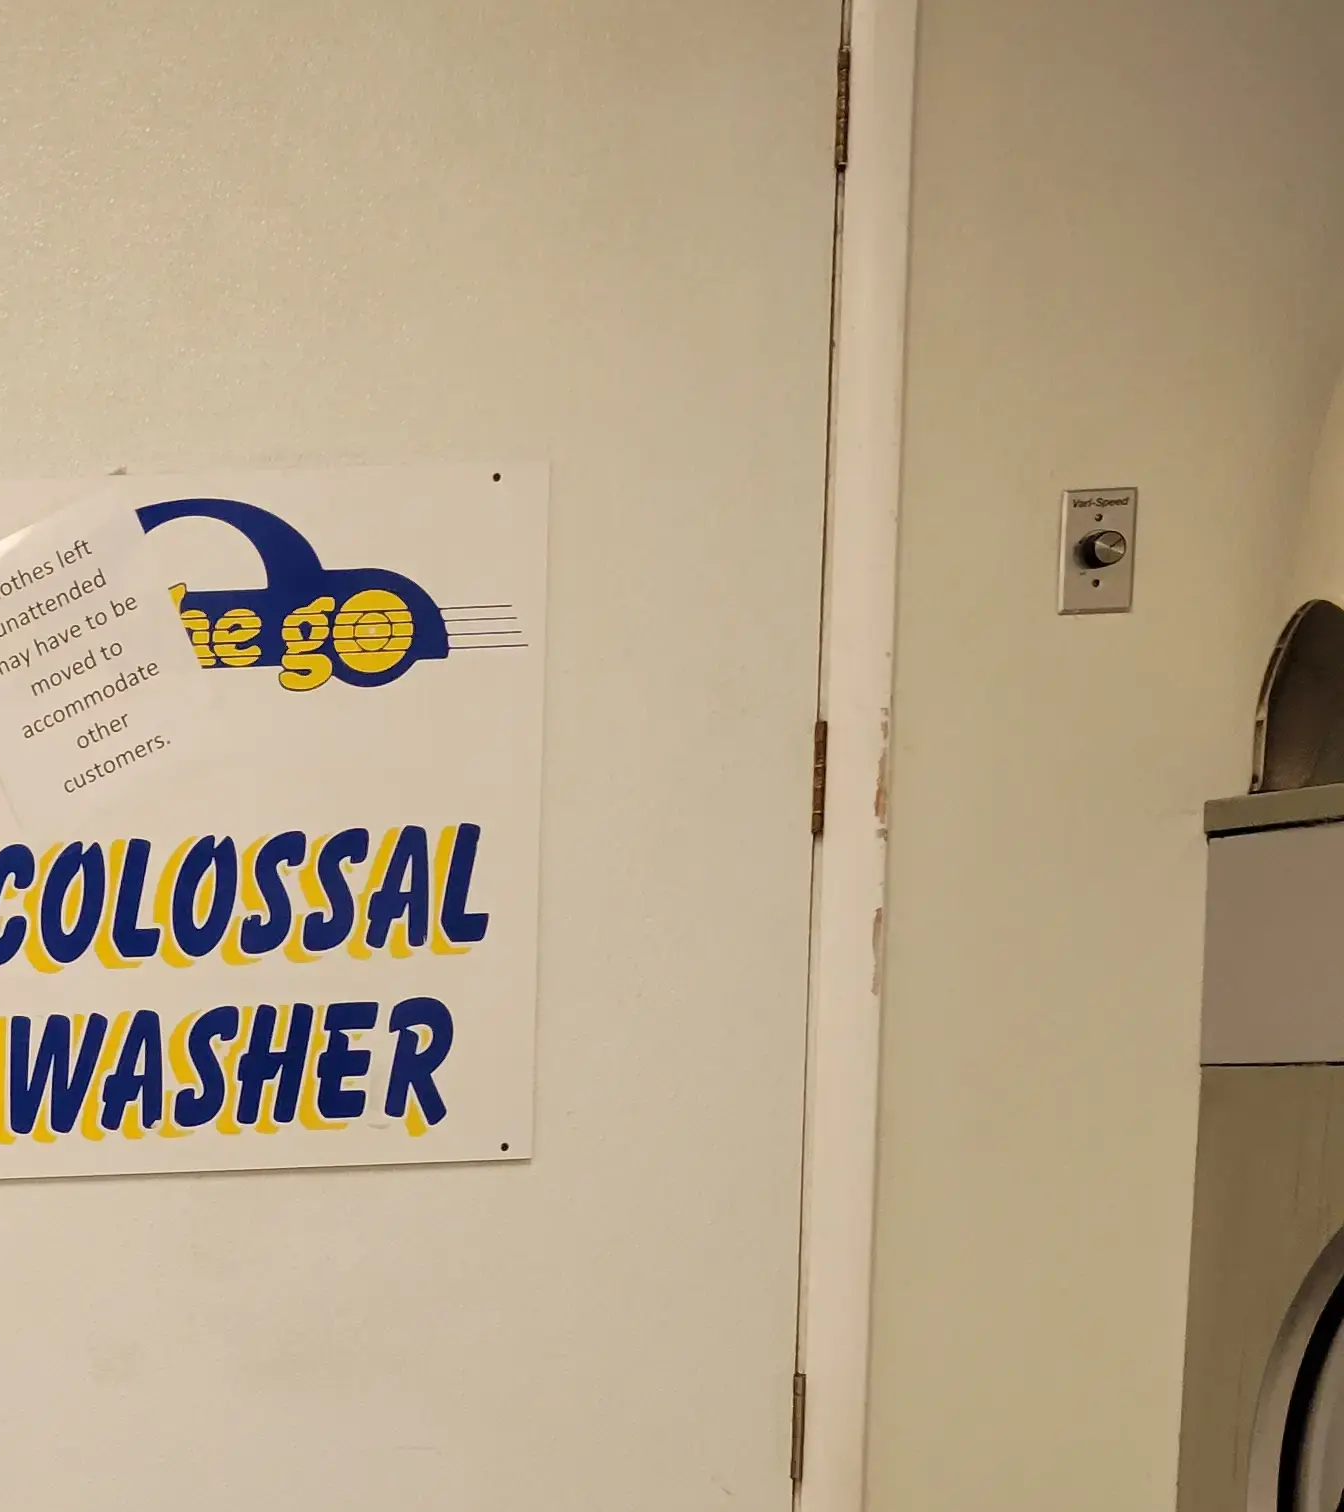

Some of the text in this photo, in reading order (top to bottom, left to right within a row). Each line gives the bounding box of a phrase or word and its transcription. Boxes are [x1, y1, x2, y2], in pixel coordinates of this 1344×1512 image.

[1072, 497, 1130, 508] Vari-Speed
[56, 539, 93, 568] left
[34, 624, 83, 656] have
[85, 612, 108, 633] to
[111, 595, 138, 617] be
[168, 582, 414, 692] he go
[30, 641, 124, 697] moved to
[21, 659, 161, 740] accommodate
[76, 711, 130, 750] other
[63, 733, 171, 793] customers.
